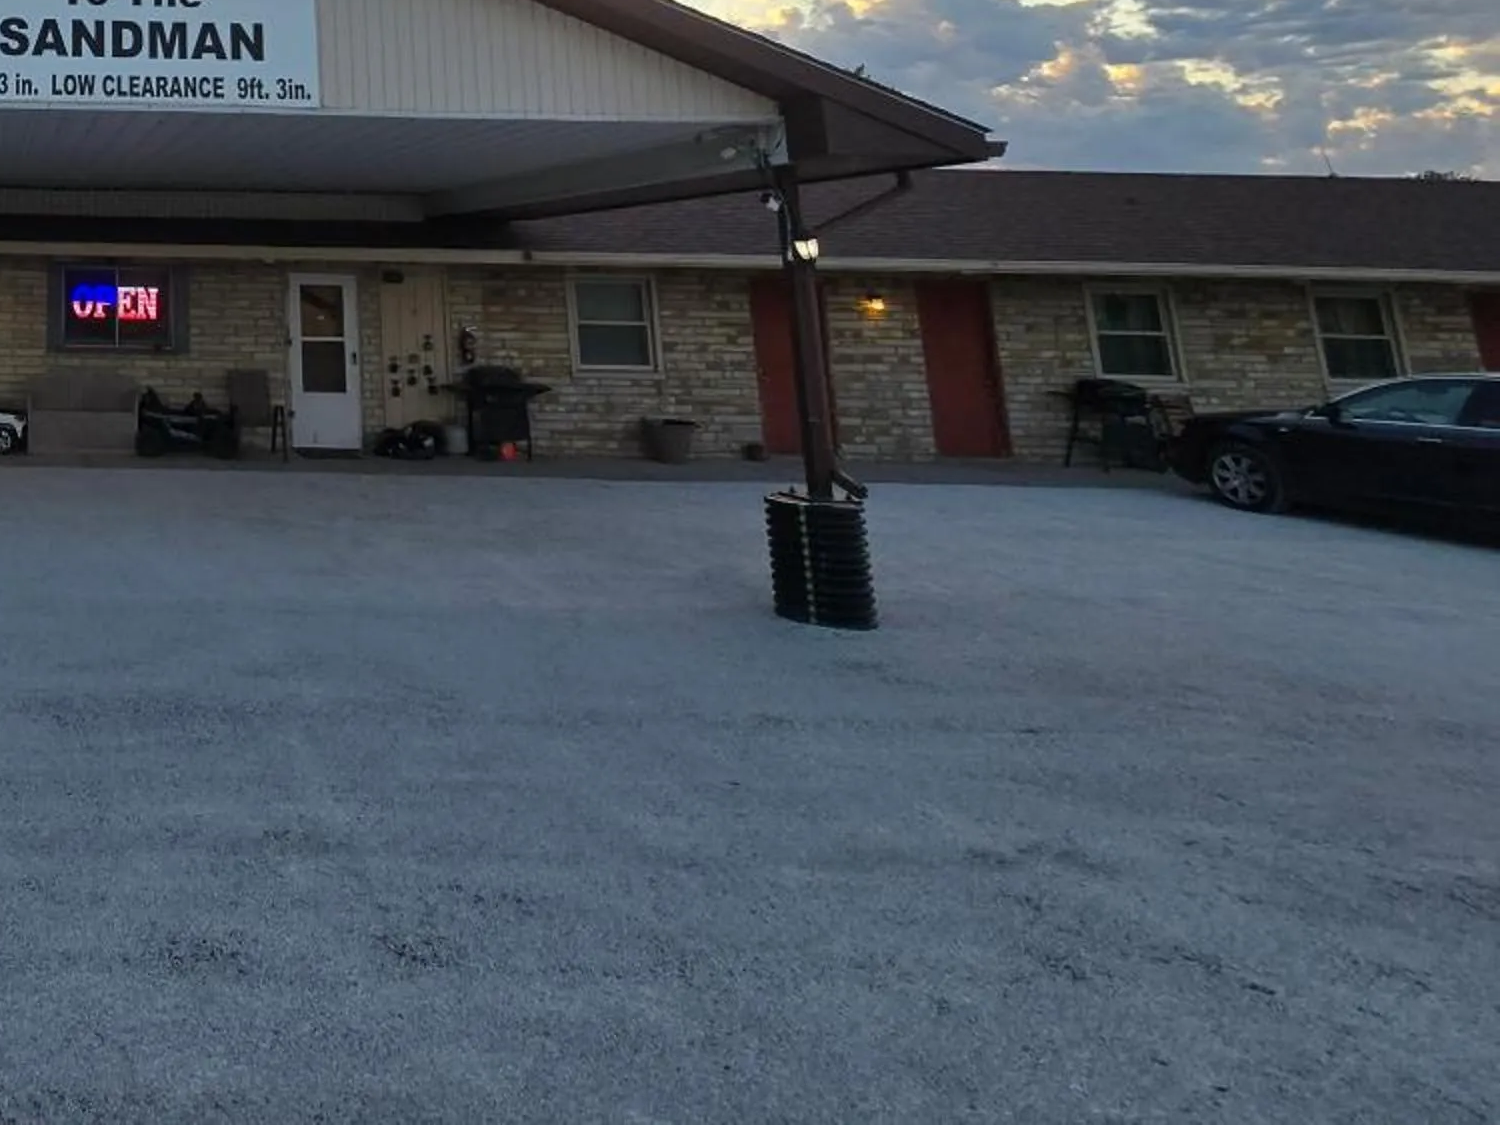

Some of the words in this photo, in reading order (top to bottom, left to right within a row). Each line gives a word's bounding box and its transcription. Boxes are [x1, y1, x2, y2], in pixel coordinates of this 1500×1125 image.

[15, 74, 39, 96] in.
[51, 74, 97, 96] LOW
[102, 76, 225, 98] CLEARANCE
[237, 78, 270, 99] 9ft.
[276, 78, 312, 100] 3in.
[72, 284, 159, 319] OPEN
